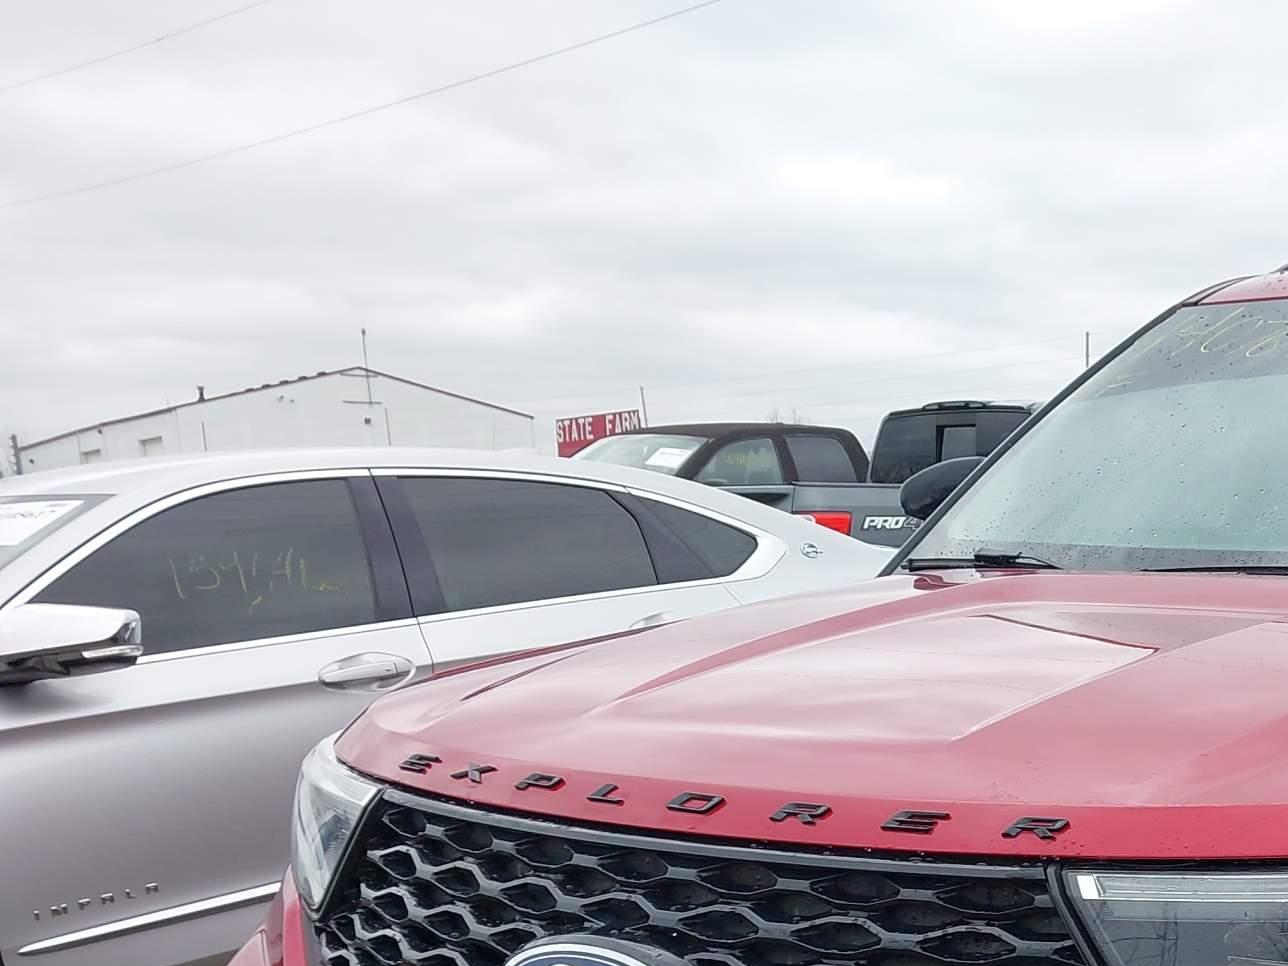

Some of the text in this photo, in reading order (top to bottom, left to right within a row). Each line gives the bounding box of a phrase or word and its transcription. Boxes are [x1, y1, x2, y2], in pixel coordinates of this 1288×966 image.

[556, 411, 640, 443] STATE FARM
[398, 753, 1070, 840] EXPLORER
[32, 882, 159, 921] IMPALA
